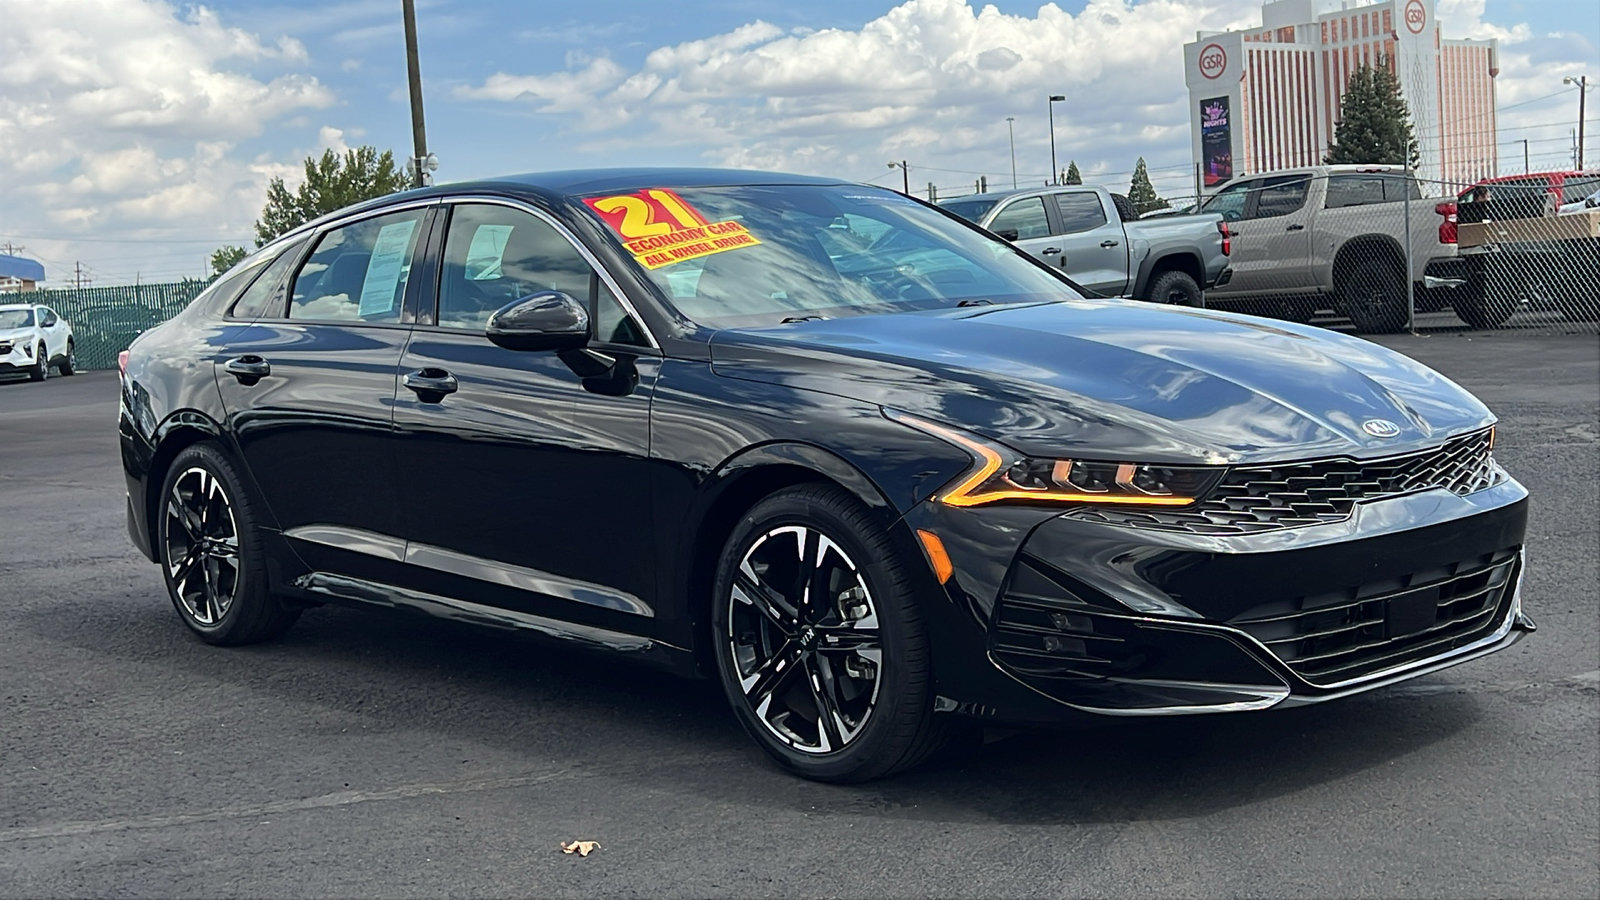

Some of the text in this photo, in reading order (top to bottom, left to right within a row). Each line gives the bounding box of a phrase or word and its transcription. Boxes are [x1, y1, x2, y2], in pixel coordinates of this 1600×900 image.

[1408, 9, 1423, 23] GSR
[1203, 53, 1223, 70] GSR
[1203, 118, 1227, 128] NIGHTS
[593, 189, 702, 239] 21
[627, 221, 745, 254] ECONOMY CAR
[644, 234, 754, 267] ALL WHEEL DRIVE
[1365, 420, 1398, 434] KIA
